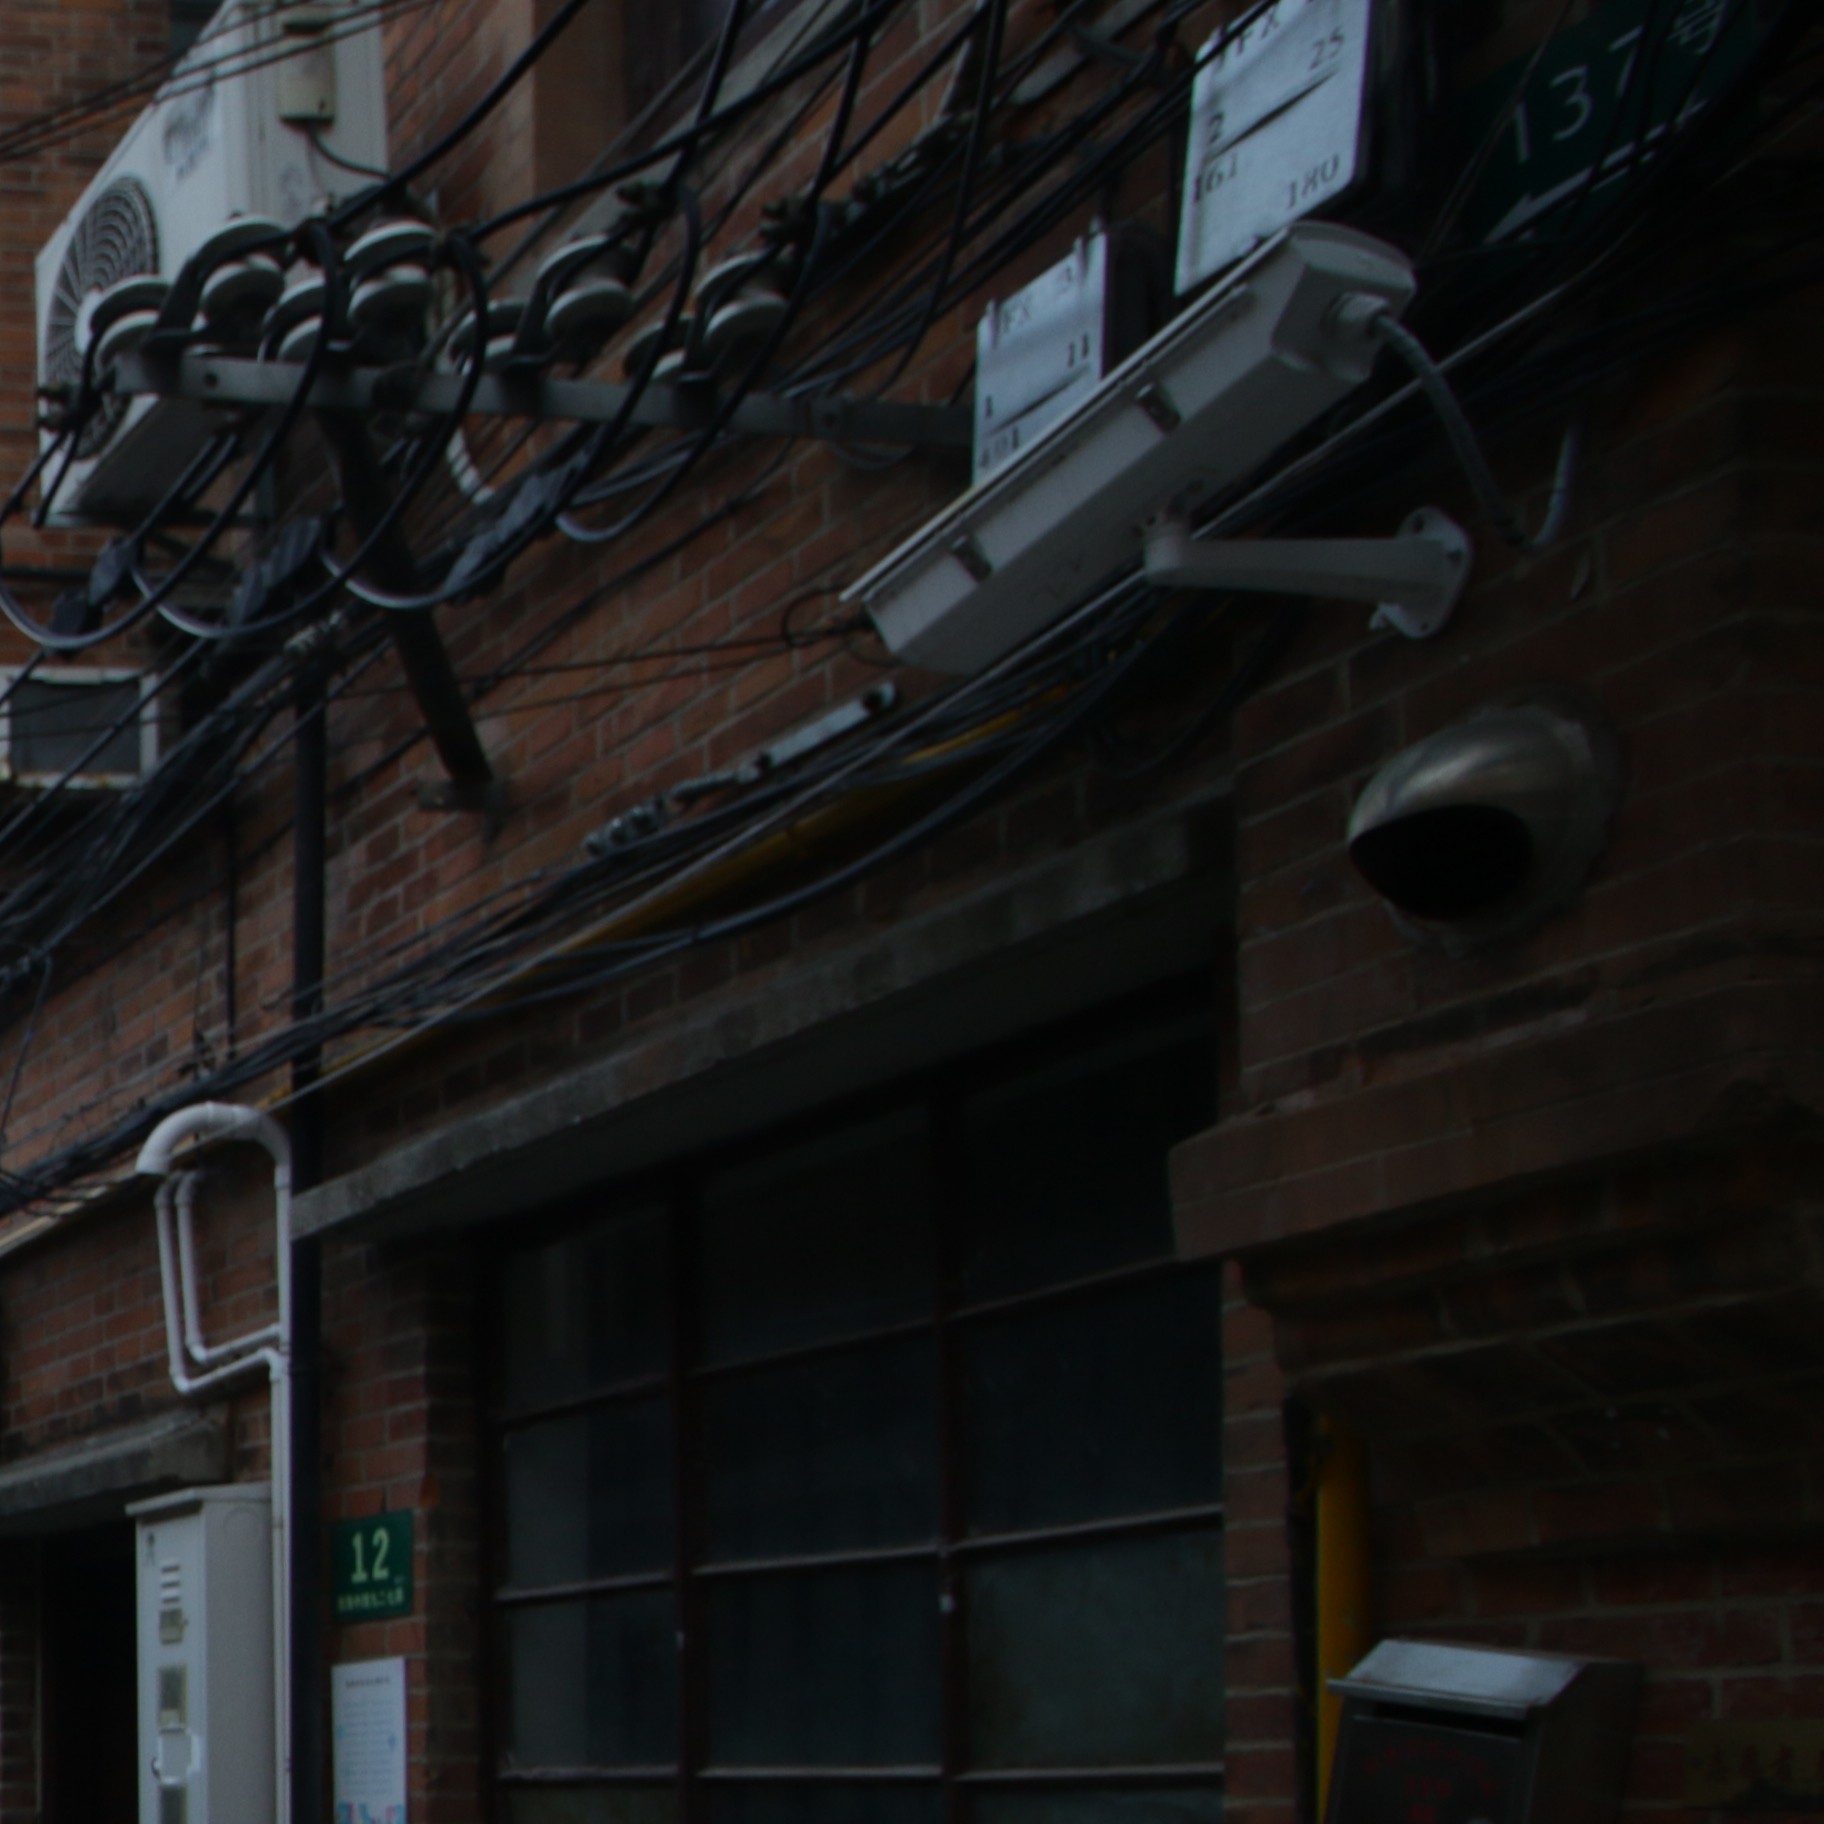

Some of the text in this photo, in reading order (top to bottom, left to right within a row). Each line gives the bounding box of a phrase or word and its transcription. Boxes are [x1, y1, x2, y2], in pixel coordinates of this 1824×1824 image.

[1307, 24, 1345, 71] 25
[1209, 110, 1225, 144] 2
[350, 1525, 391, 1585] 12
